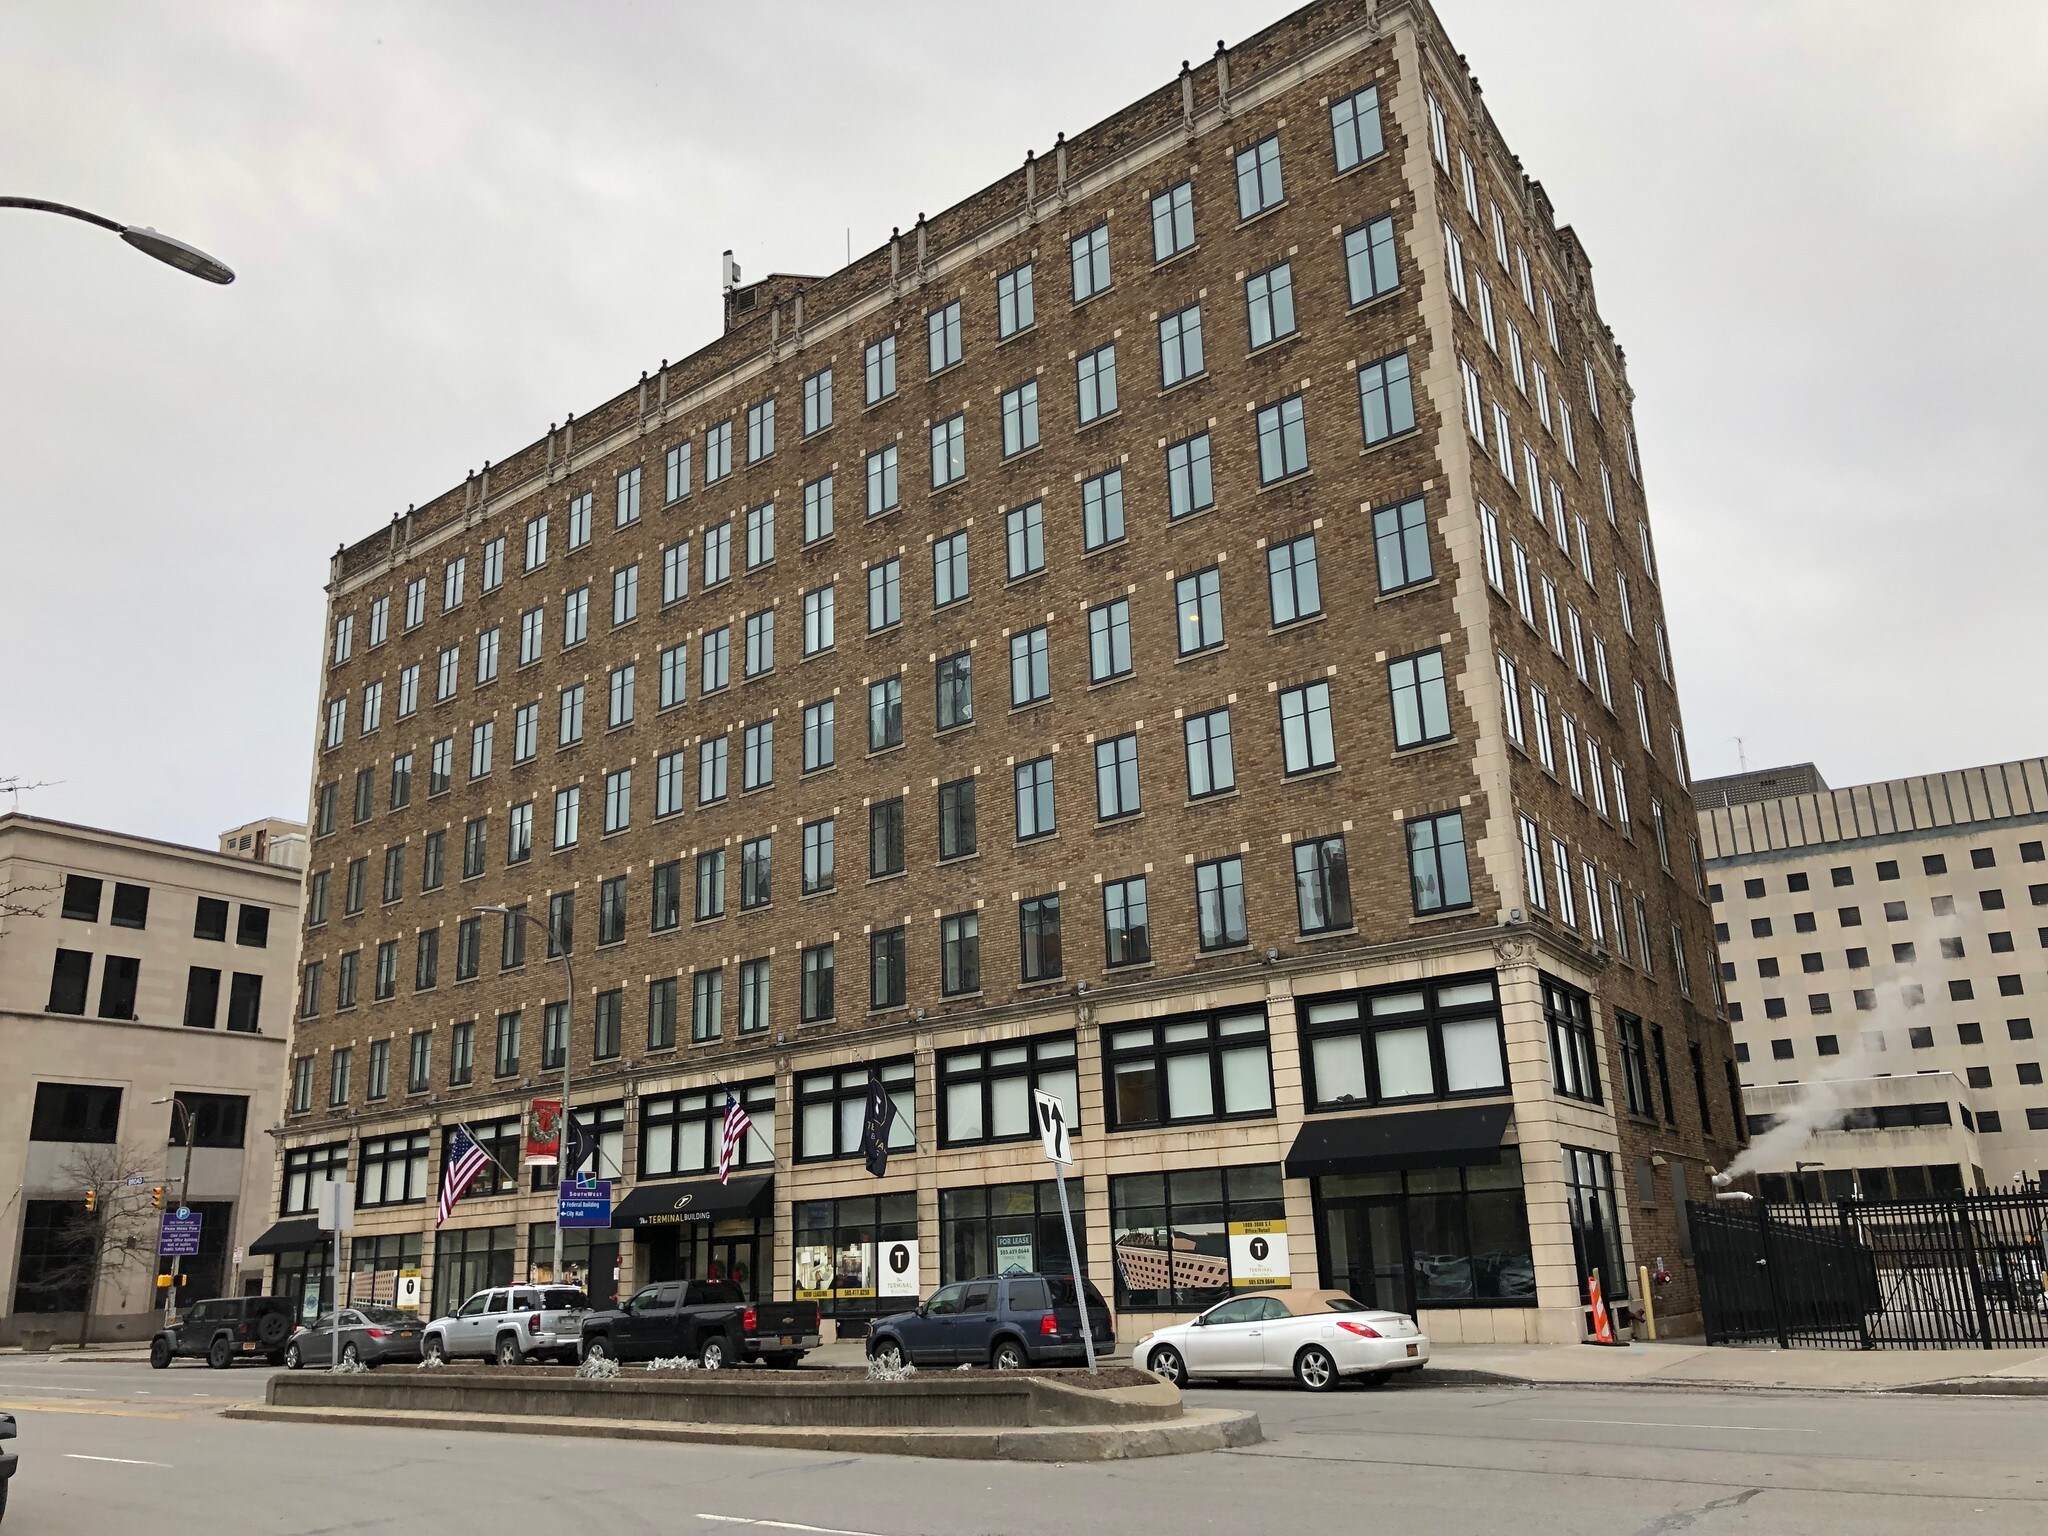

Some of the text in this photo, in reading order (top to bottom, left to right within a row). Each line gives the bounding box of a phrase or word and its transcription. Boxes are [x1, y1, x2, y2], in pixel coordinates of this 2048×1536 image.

[582, 1201, 600, 1209] Building
[566, 1210, 575, 1218] City
[1255, 1243, 1263, 1256] T
[895, 1252, 904, 1268] T
